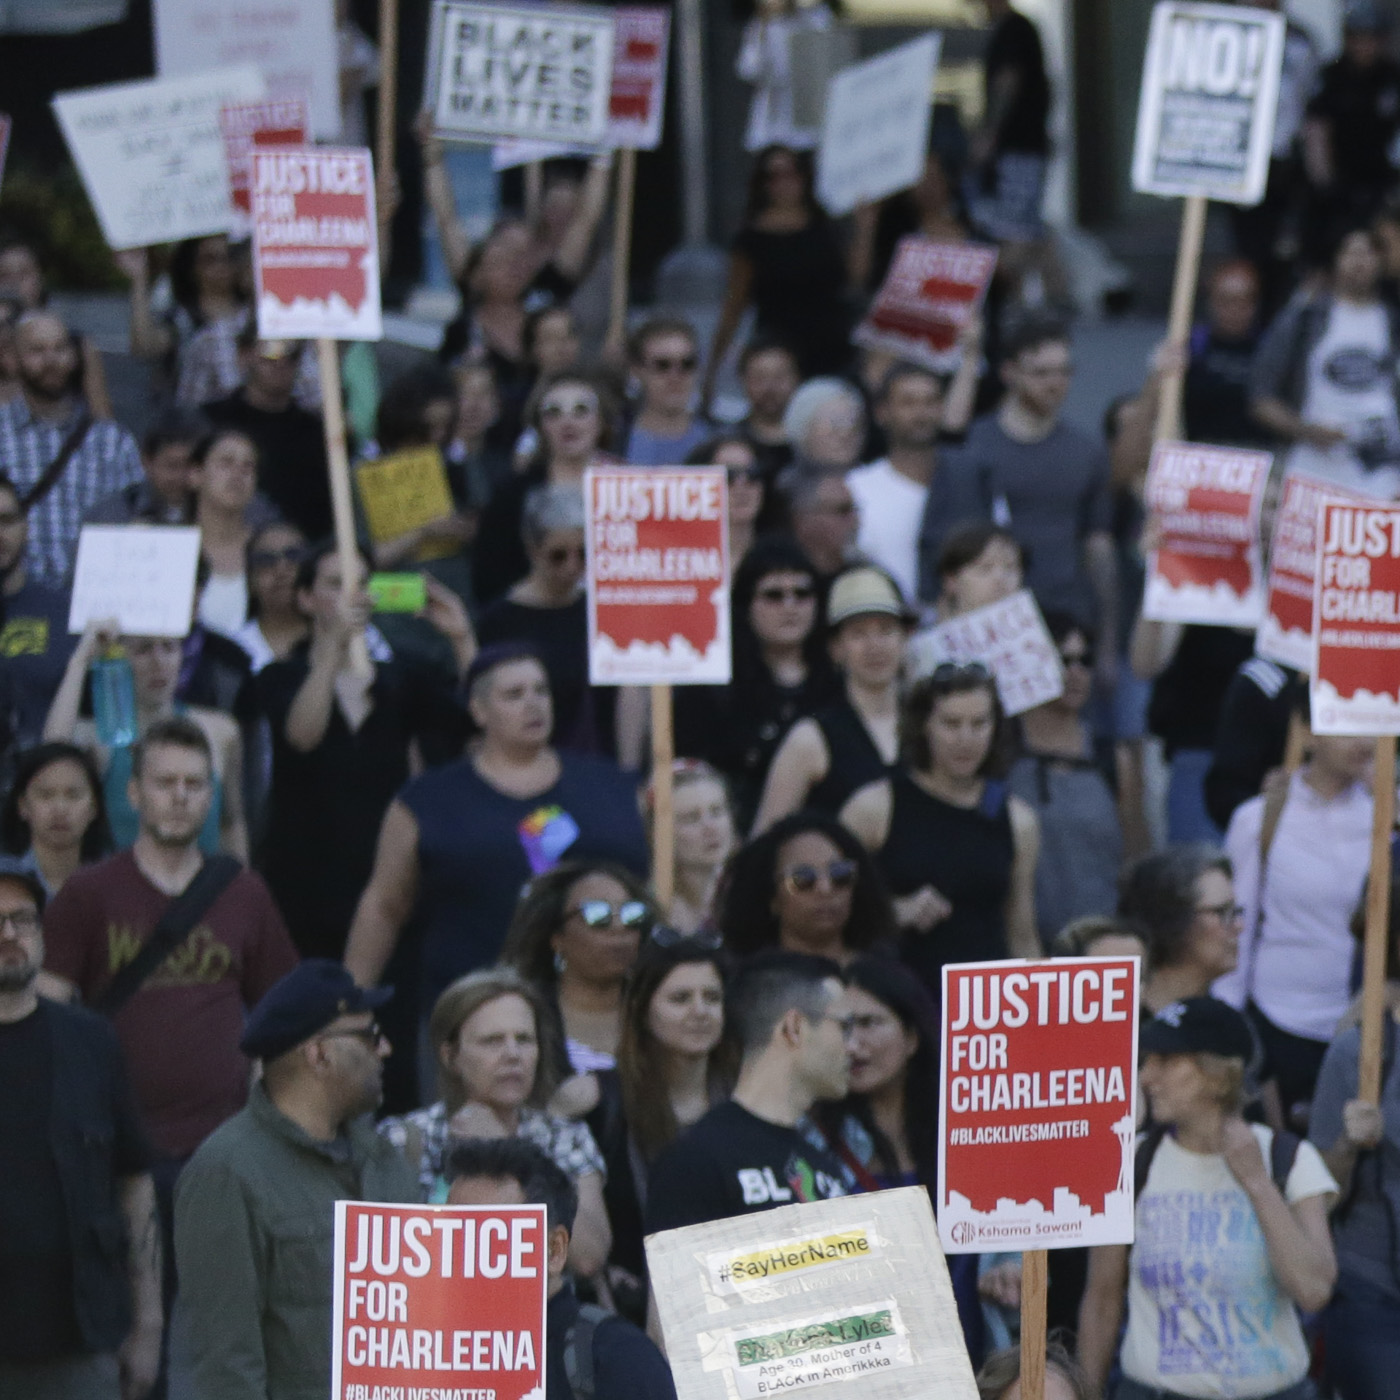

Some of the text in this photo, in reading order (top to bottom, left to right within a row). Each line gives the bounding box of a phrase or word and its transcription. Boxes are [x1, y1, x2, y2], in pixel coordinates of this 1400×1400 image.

[456, 21, 595, 52] BLACK
[453, 55, 593, 90] LIVES
[1163, 20, 1263, 96] NO!
[450, 93, 590, 123] MATTER
[257, 154, 364, 194] JUSTICE
[592, 477, 721, 521] JUSTICE
[593, 519, 638, 550] FOR
[595, 546, 723, 581] CHARLEENA
[1323, 555, 1371, 589] FOR
[951, 967, 1128, 1032] JUSTICE
[952, 1033, 1008, 1072] FOR
[950, 1066, 1127, 1114] CHARLEENA
[950, 1119, 1090, 1146] #BLACKLIVESMATTER
[349, 1213, 538, 1279] JUSTICE
[719, 1236, 870, 1283] #SayHerName
[349, 1278, 408, 1324] FOR
[346, 1324, 537, 1372] CHARLEENA
[758, 1363, 785, 1377] Age
[811, 1346, 857, 1365] Mother
[859, 1343, 871, 1355] of
[874, 1340, 882, 1352] 4
[757, 1356, 892, 1393] BLACK in Amerikkka
